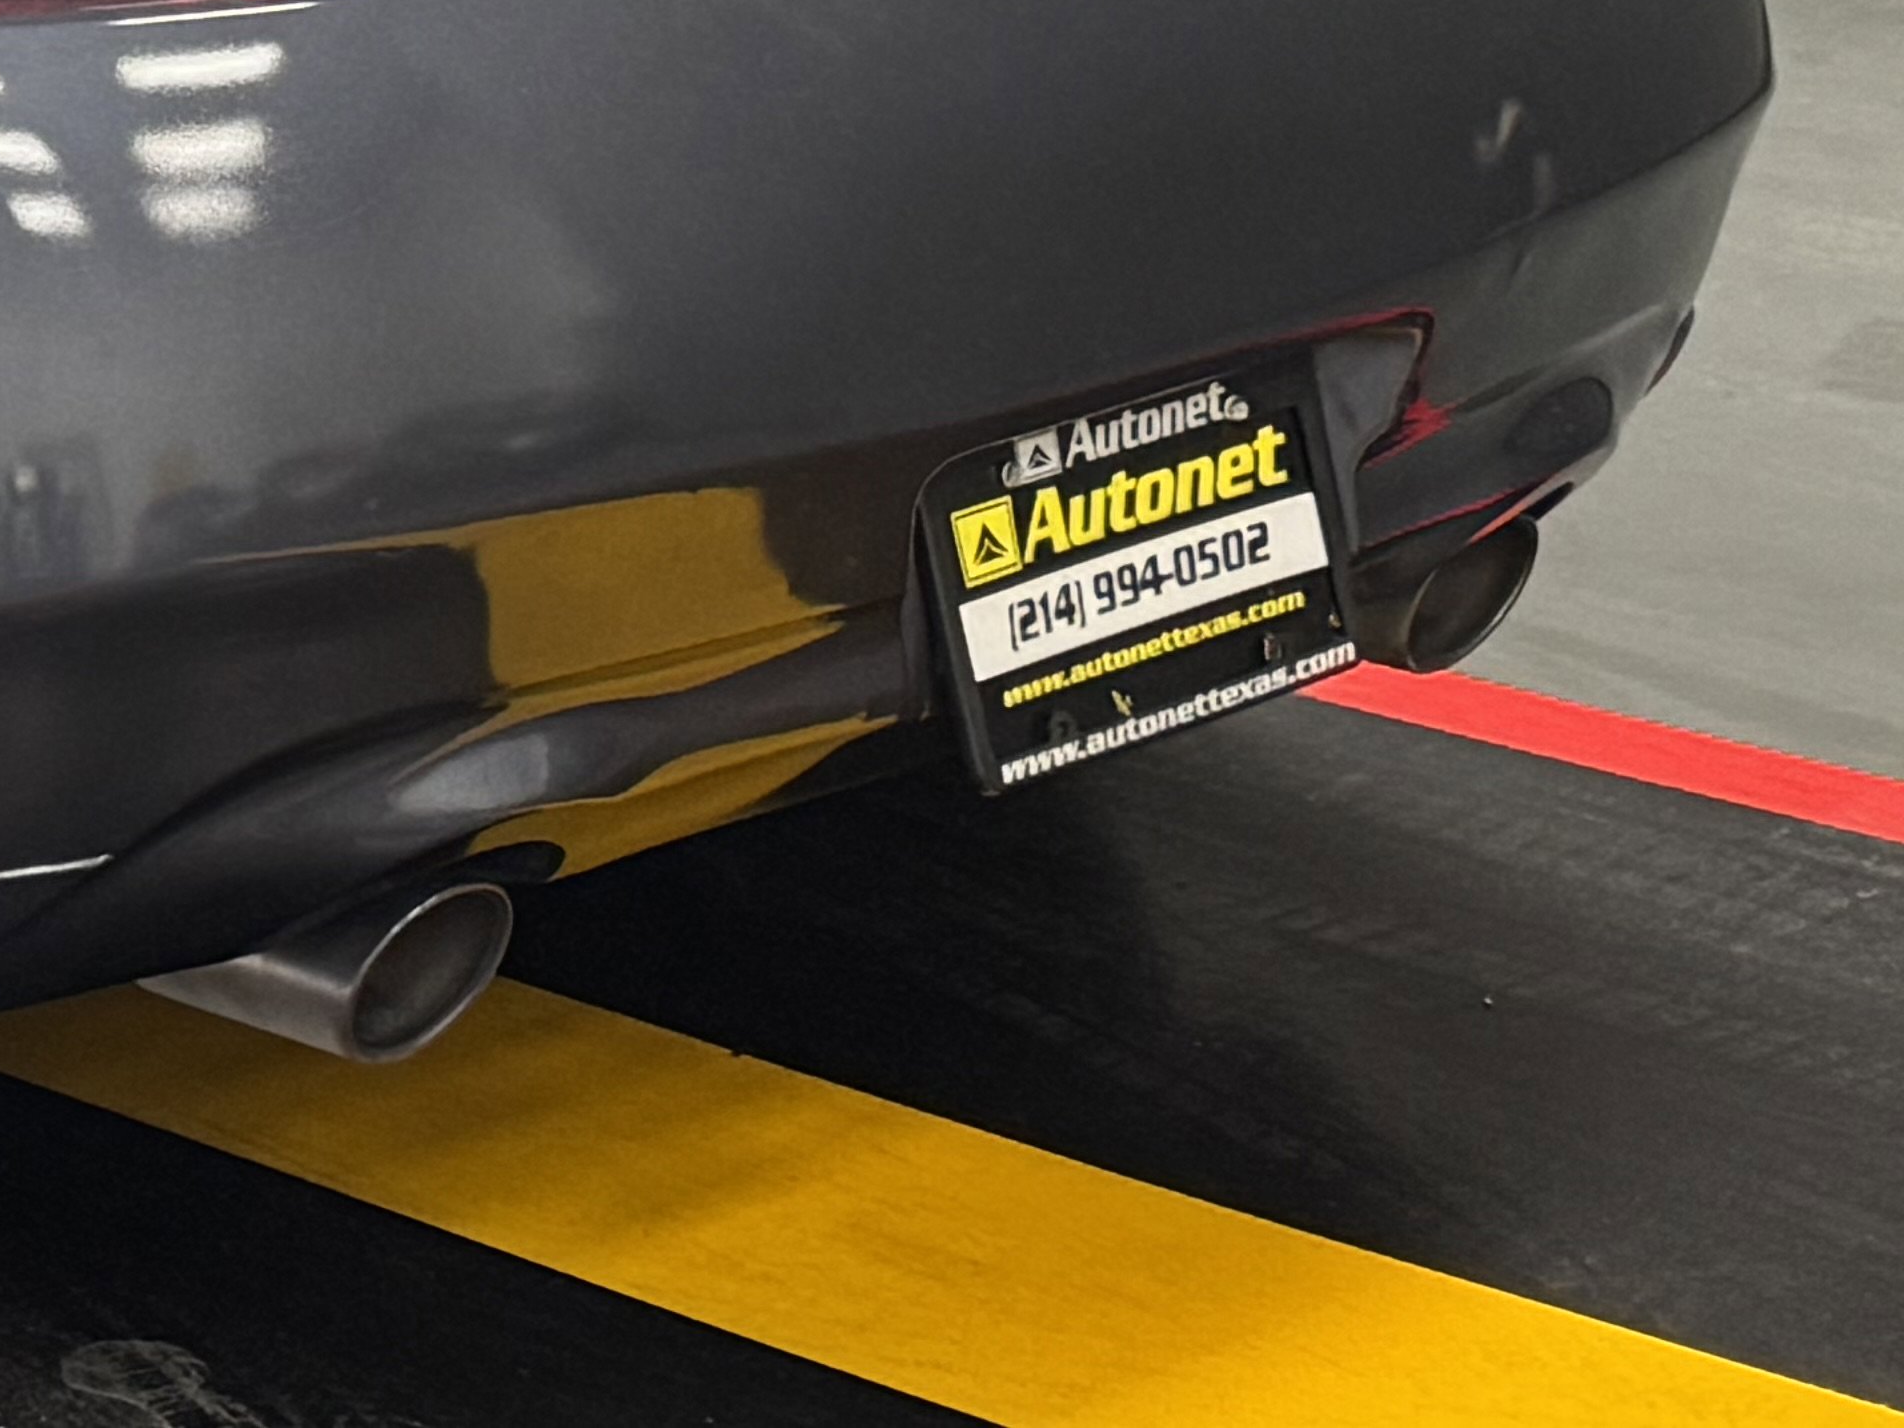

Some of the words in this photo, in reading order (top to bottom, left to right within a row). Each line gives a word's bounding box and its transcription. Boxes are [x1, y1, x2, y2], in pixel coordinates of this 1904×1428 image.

[1064, 381, 1226, 468] Autonet
[1022, 424, 1288, 565] Autonet
[1002, 590, 1306, 708] www.autonettexas.com
[1008, 579, 1086, 652] (214)
[1093, 521, 1272, 615] 994-0502
[1000, 641, 1356, 784] www.autonettexas.com
